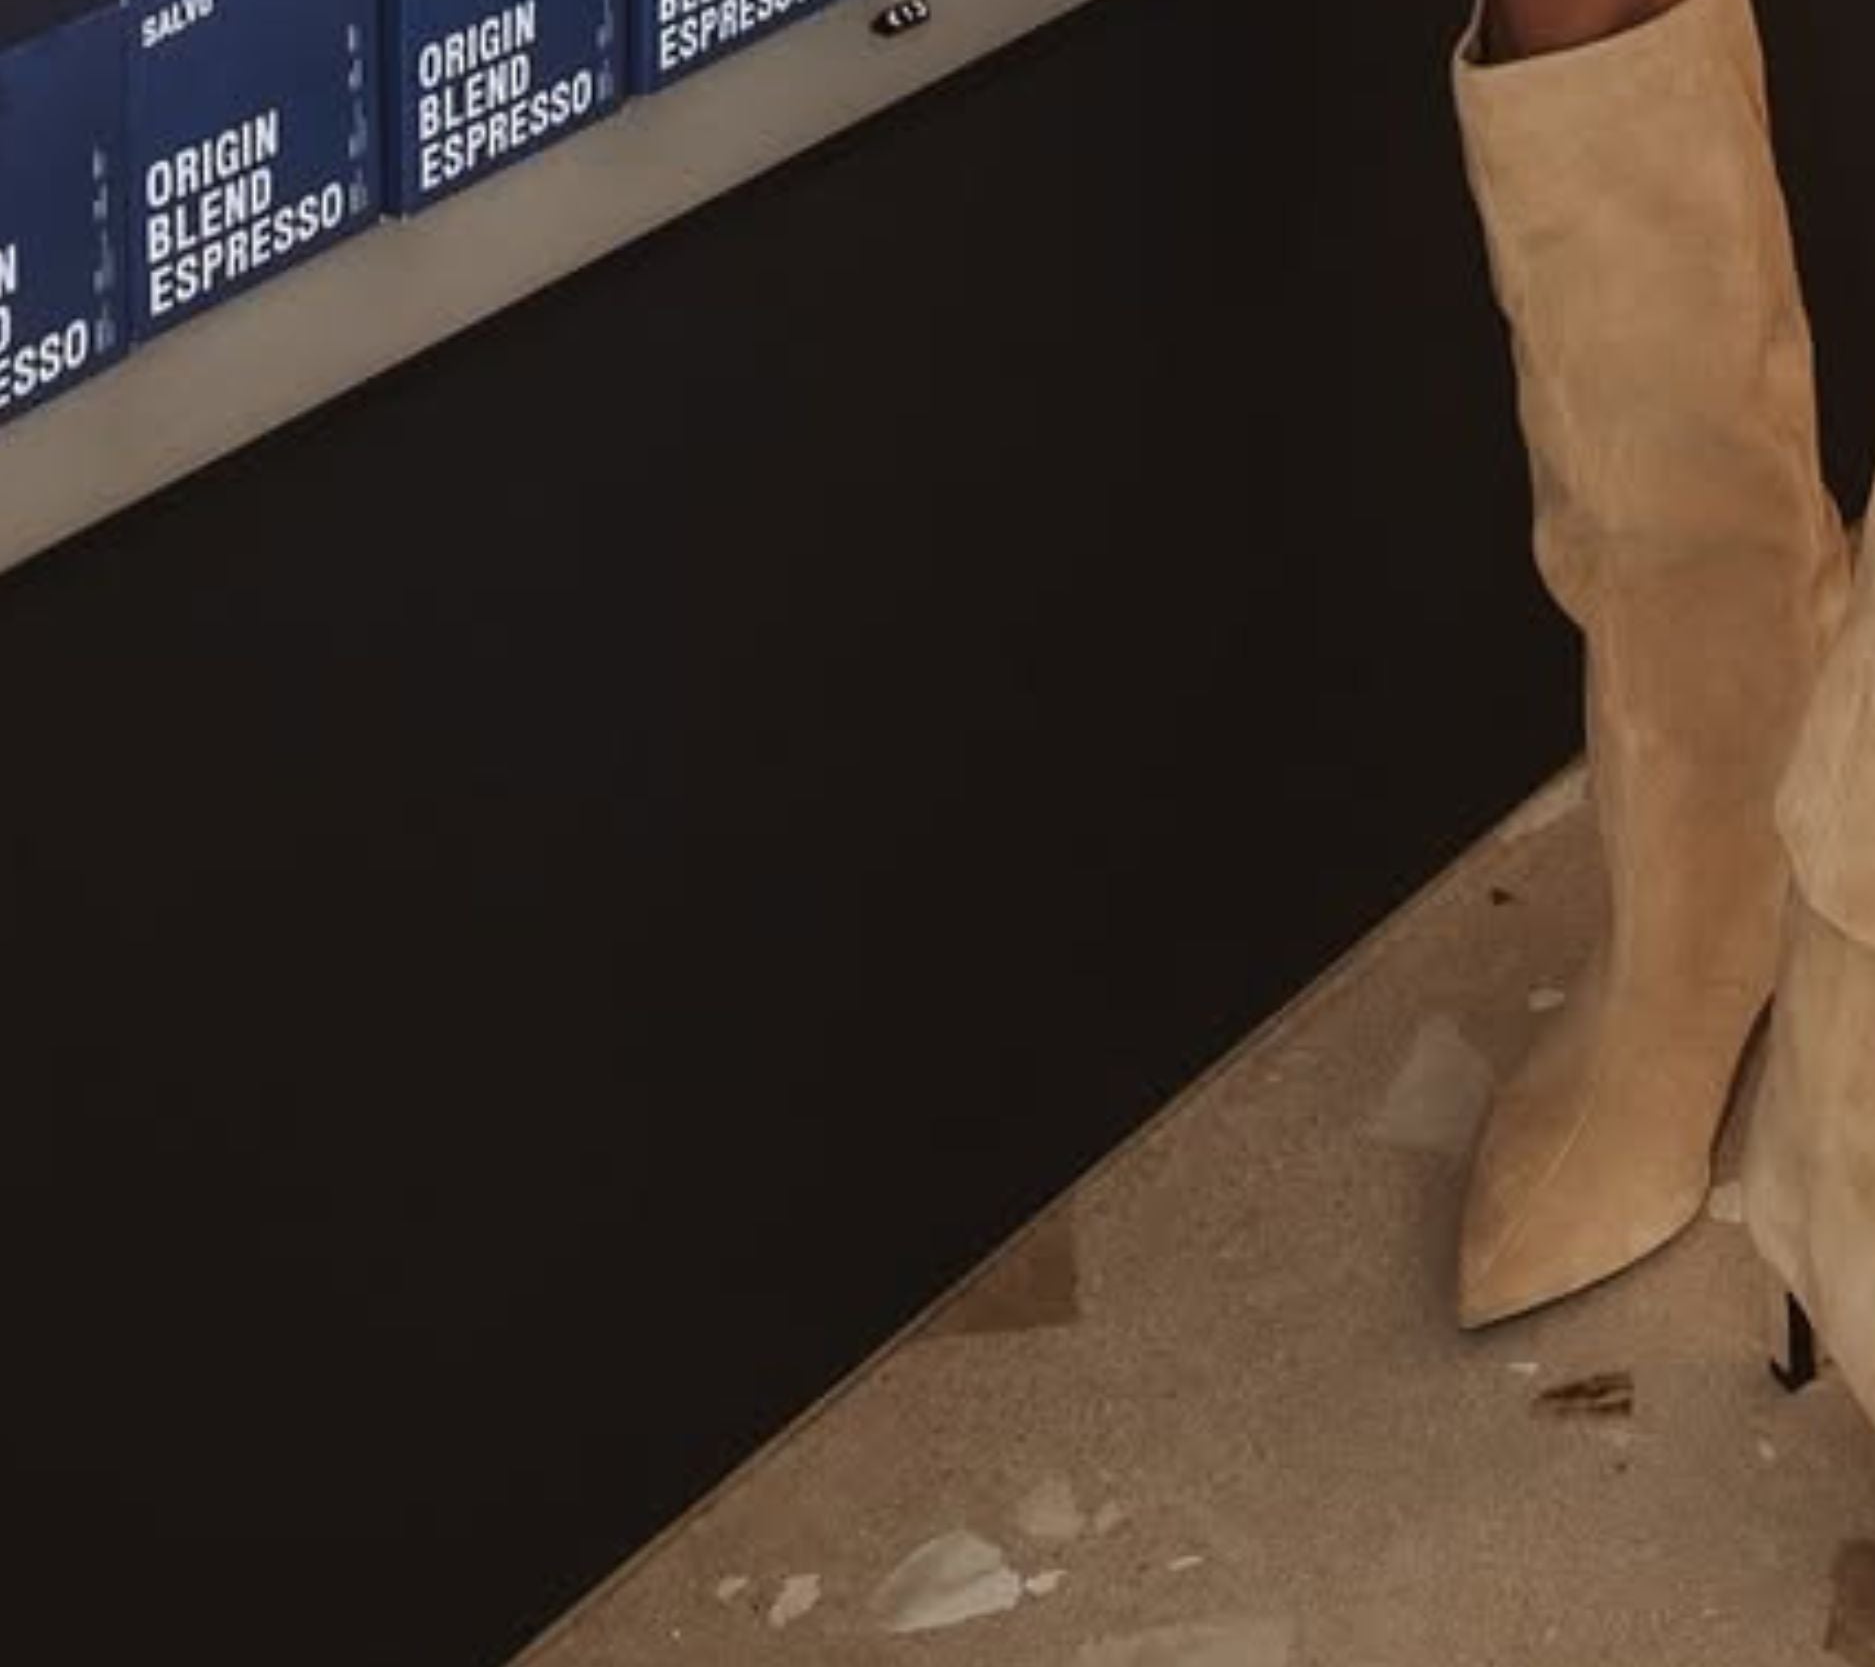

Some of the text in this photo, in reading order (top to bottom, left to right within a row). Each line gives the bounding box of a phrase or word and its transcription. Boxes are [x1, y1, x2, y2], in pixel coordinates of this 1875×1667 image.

[418, 53, 531, 142] BLEND
[420, 68, 593, 191] ESPRESSO
[146, 107, 280, 209] ORIGIN
[147, 165, 273, 264] BLEND
[149, 182, 344, 317] ESPRESSO
